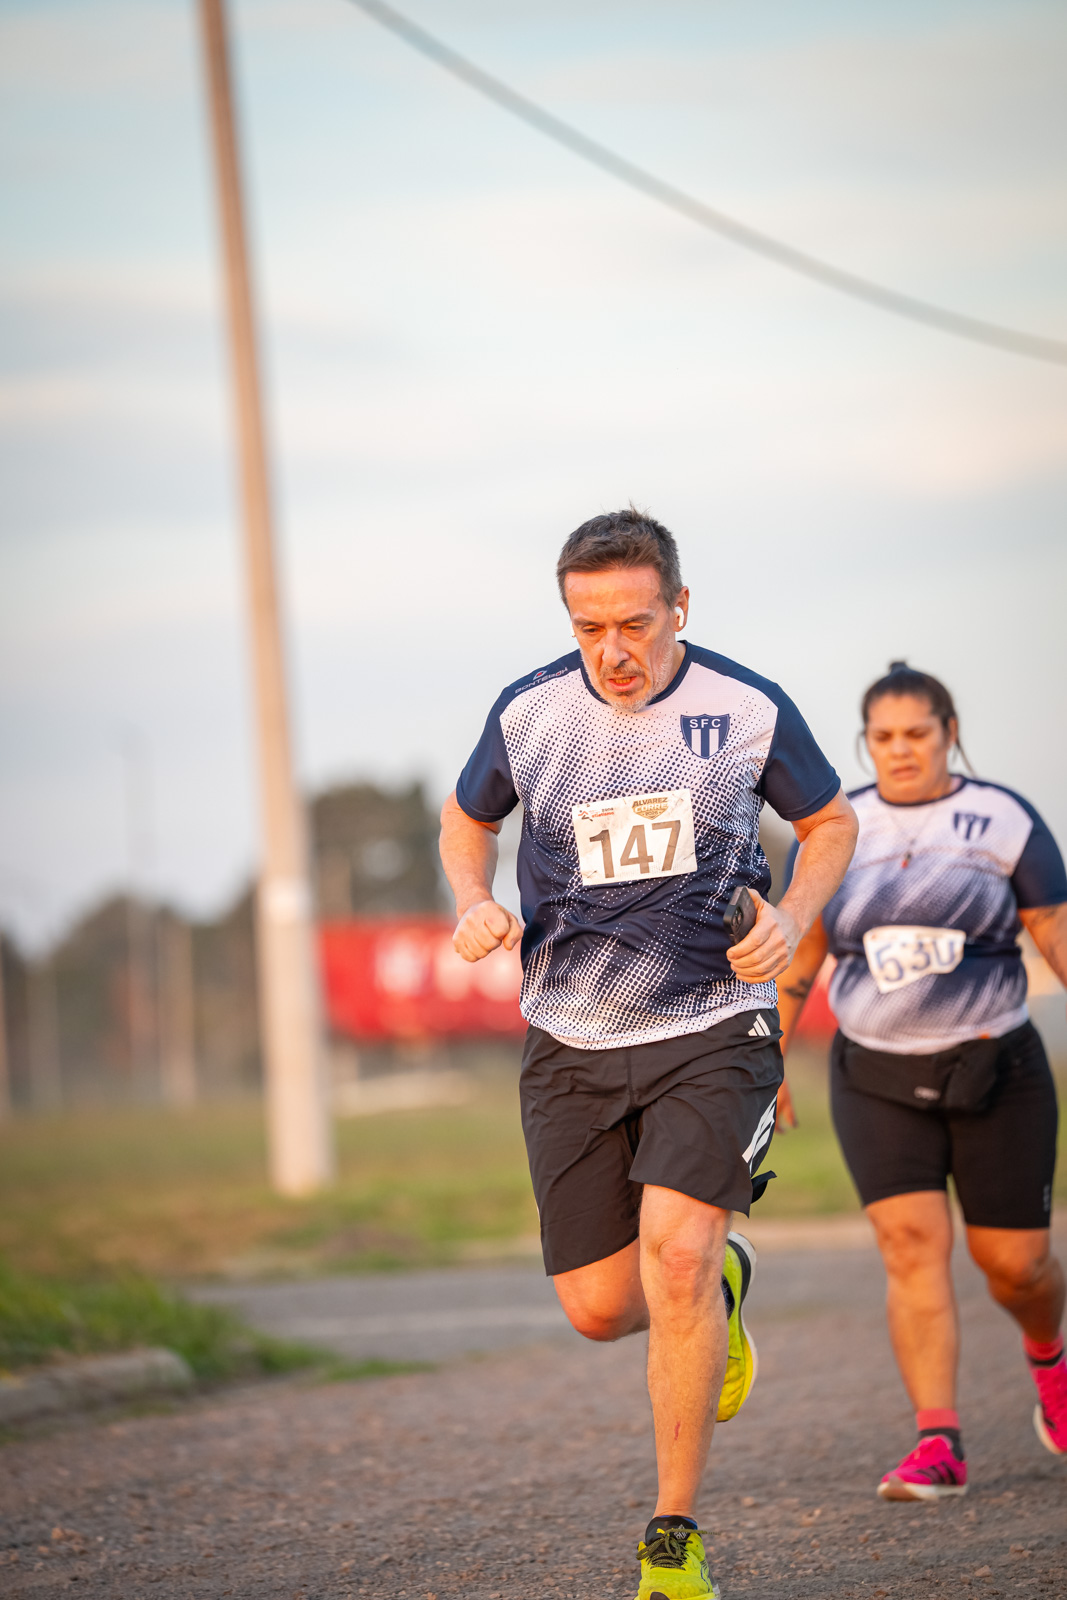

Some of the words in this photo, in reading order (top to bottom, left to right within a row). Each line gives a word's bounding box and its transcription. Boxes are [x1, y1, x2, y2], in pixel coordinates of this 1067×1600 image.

[689, 718, 721, 729] SFC
[632, 796, 668, 807] ALVAREZ
[634, 802, 668, 812] CORRE
[589, 819, 681, 878] 147
